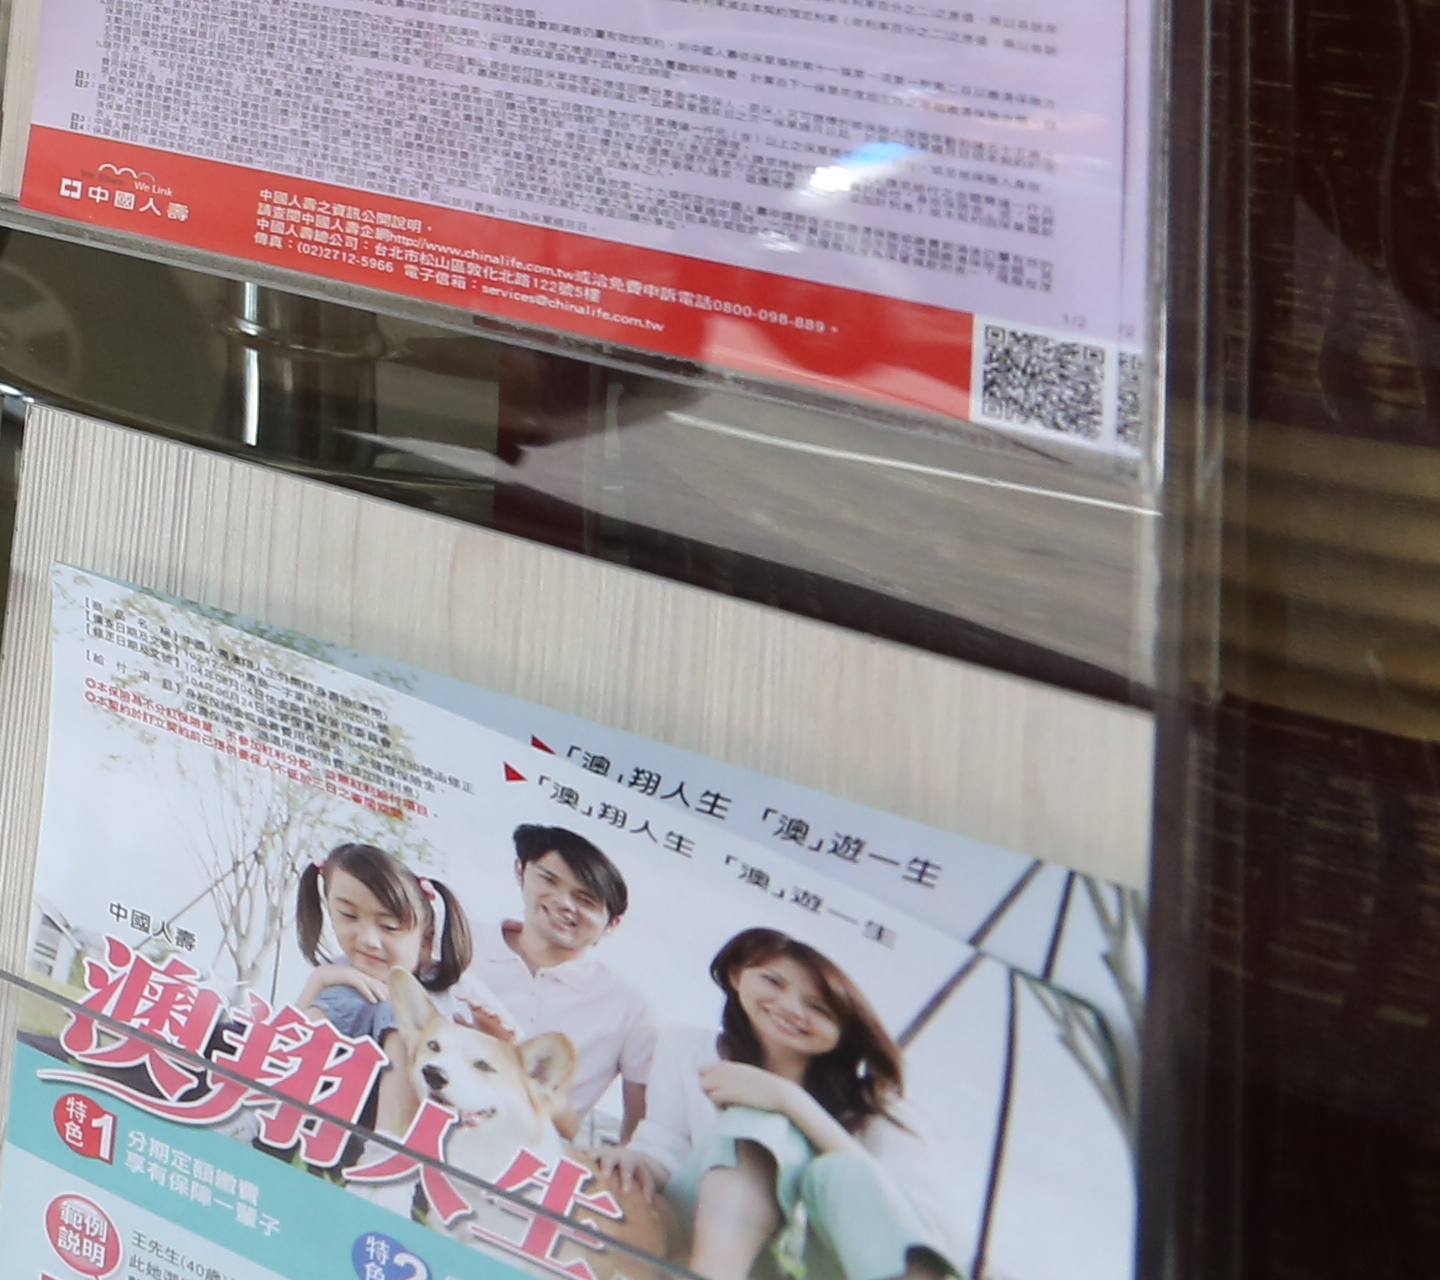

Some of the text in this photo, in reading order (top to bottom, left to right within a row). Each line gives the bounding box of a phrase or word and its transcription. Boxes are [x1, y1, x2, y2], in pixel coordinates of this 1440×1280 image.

[88, 186, 189, 222] 中國人壽
[109, 902, 198, 951] 中國人壽
[64, 1097, 117, 1162] 特色 1
[128, 1129, 260, 1208] 分期定額繳費
[60, 1201, 108, 1244] 範例
[58, 1227, 105, 1269] 說明
